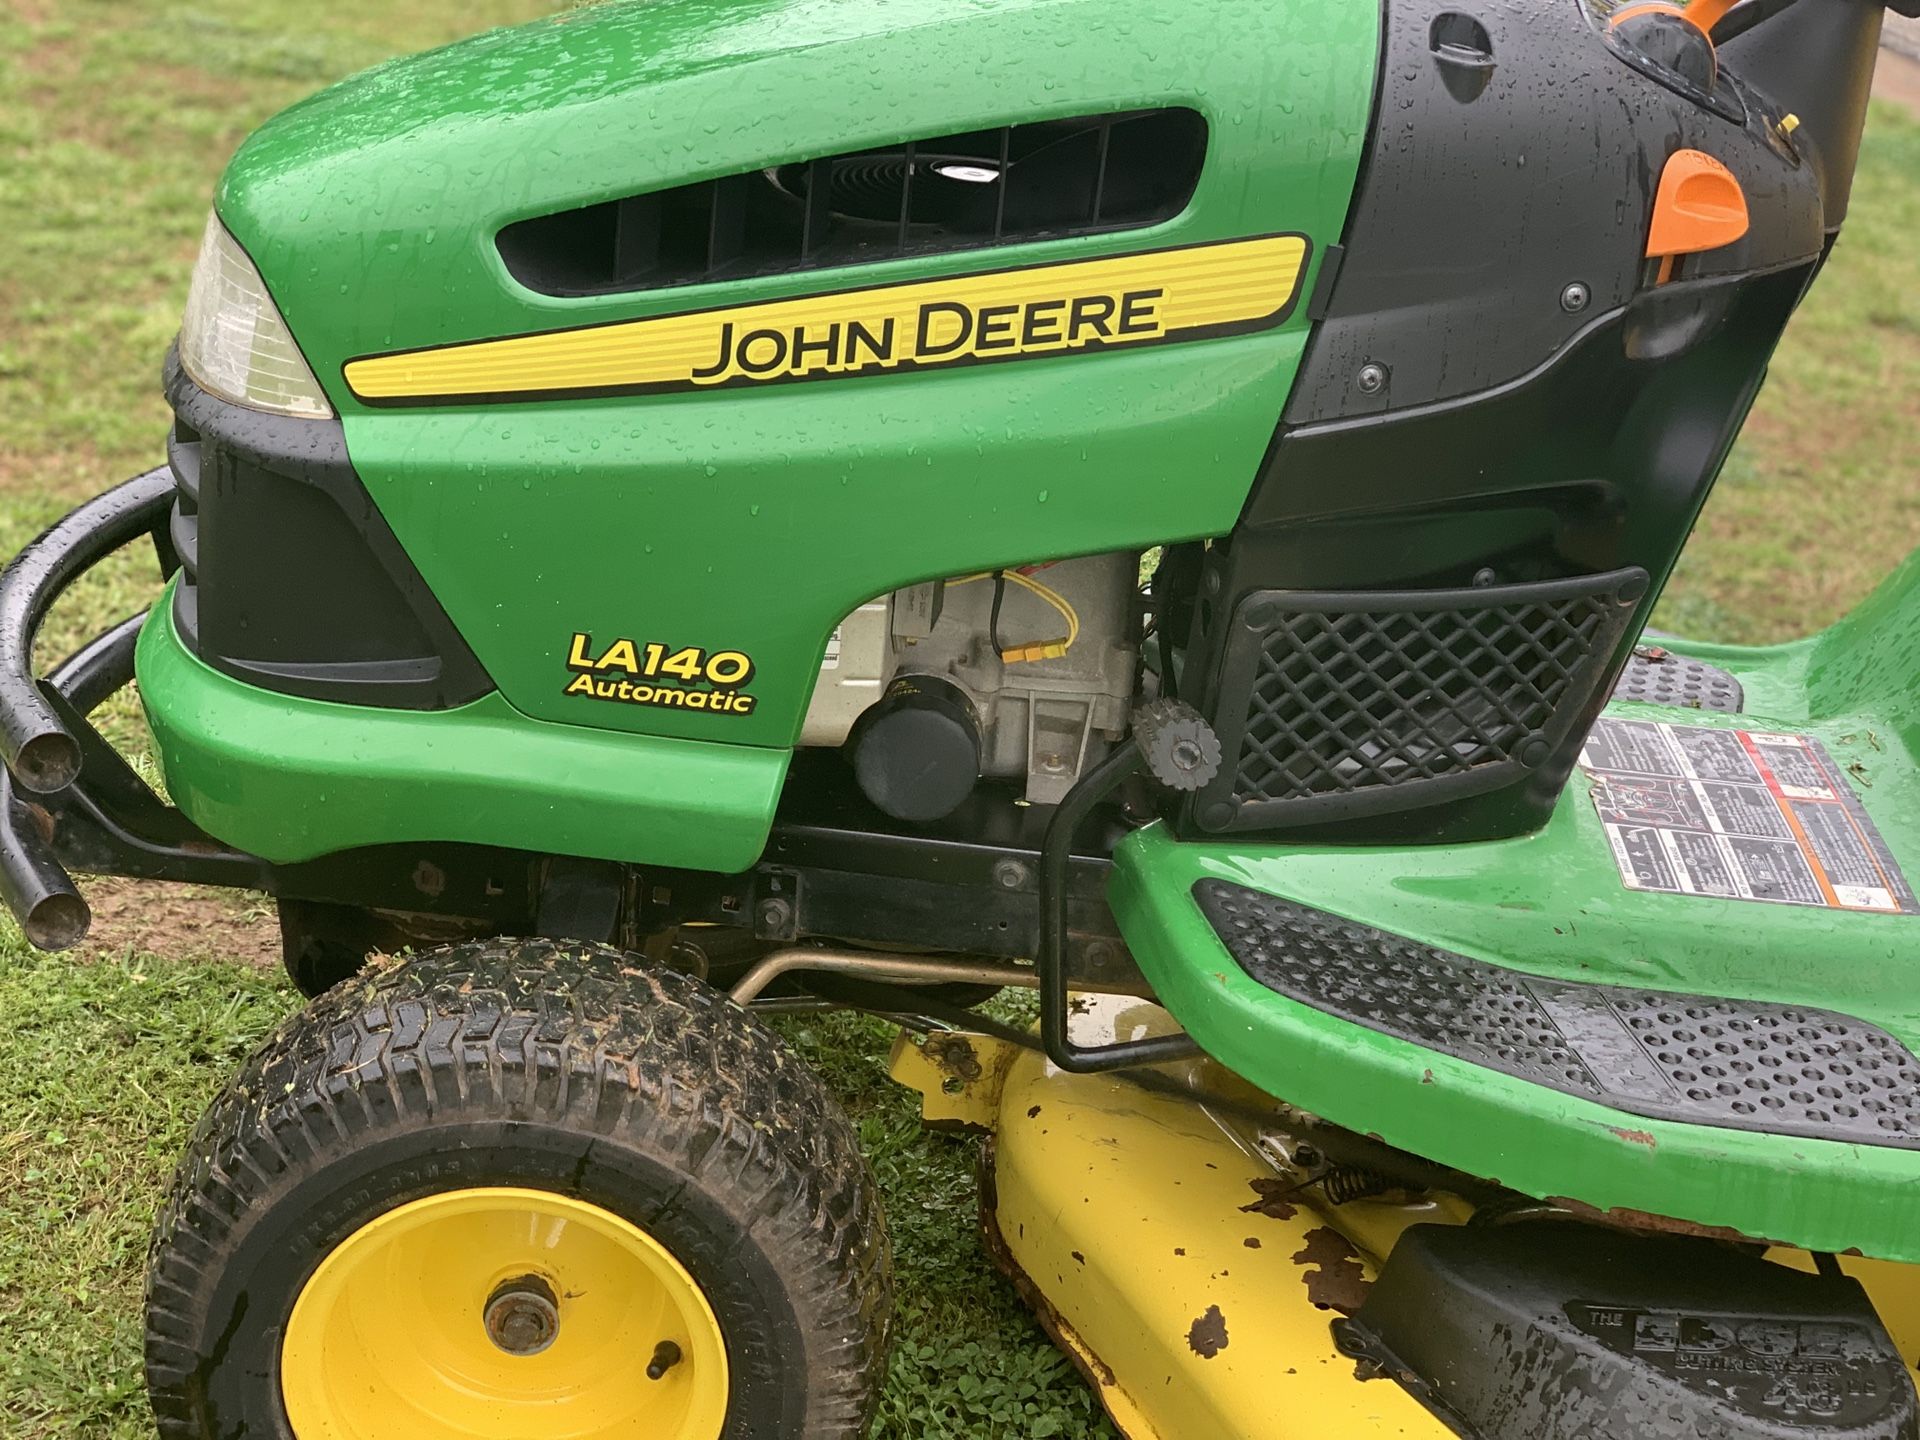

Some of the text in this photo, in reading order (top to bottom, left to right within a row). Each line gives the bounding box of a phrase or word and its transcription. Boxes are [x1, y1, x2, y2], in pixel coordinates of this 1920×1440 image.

[691, 287, 1165, 378] JOHN DEERE
[568, 633, 752, 684] LA140
[566, 673, 753, 713] Automatic
[1589, 1311, 1623, 1327] THE
